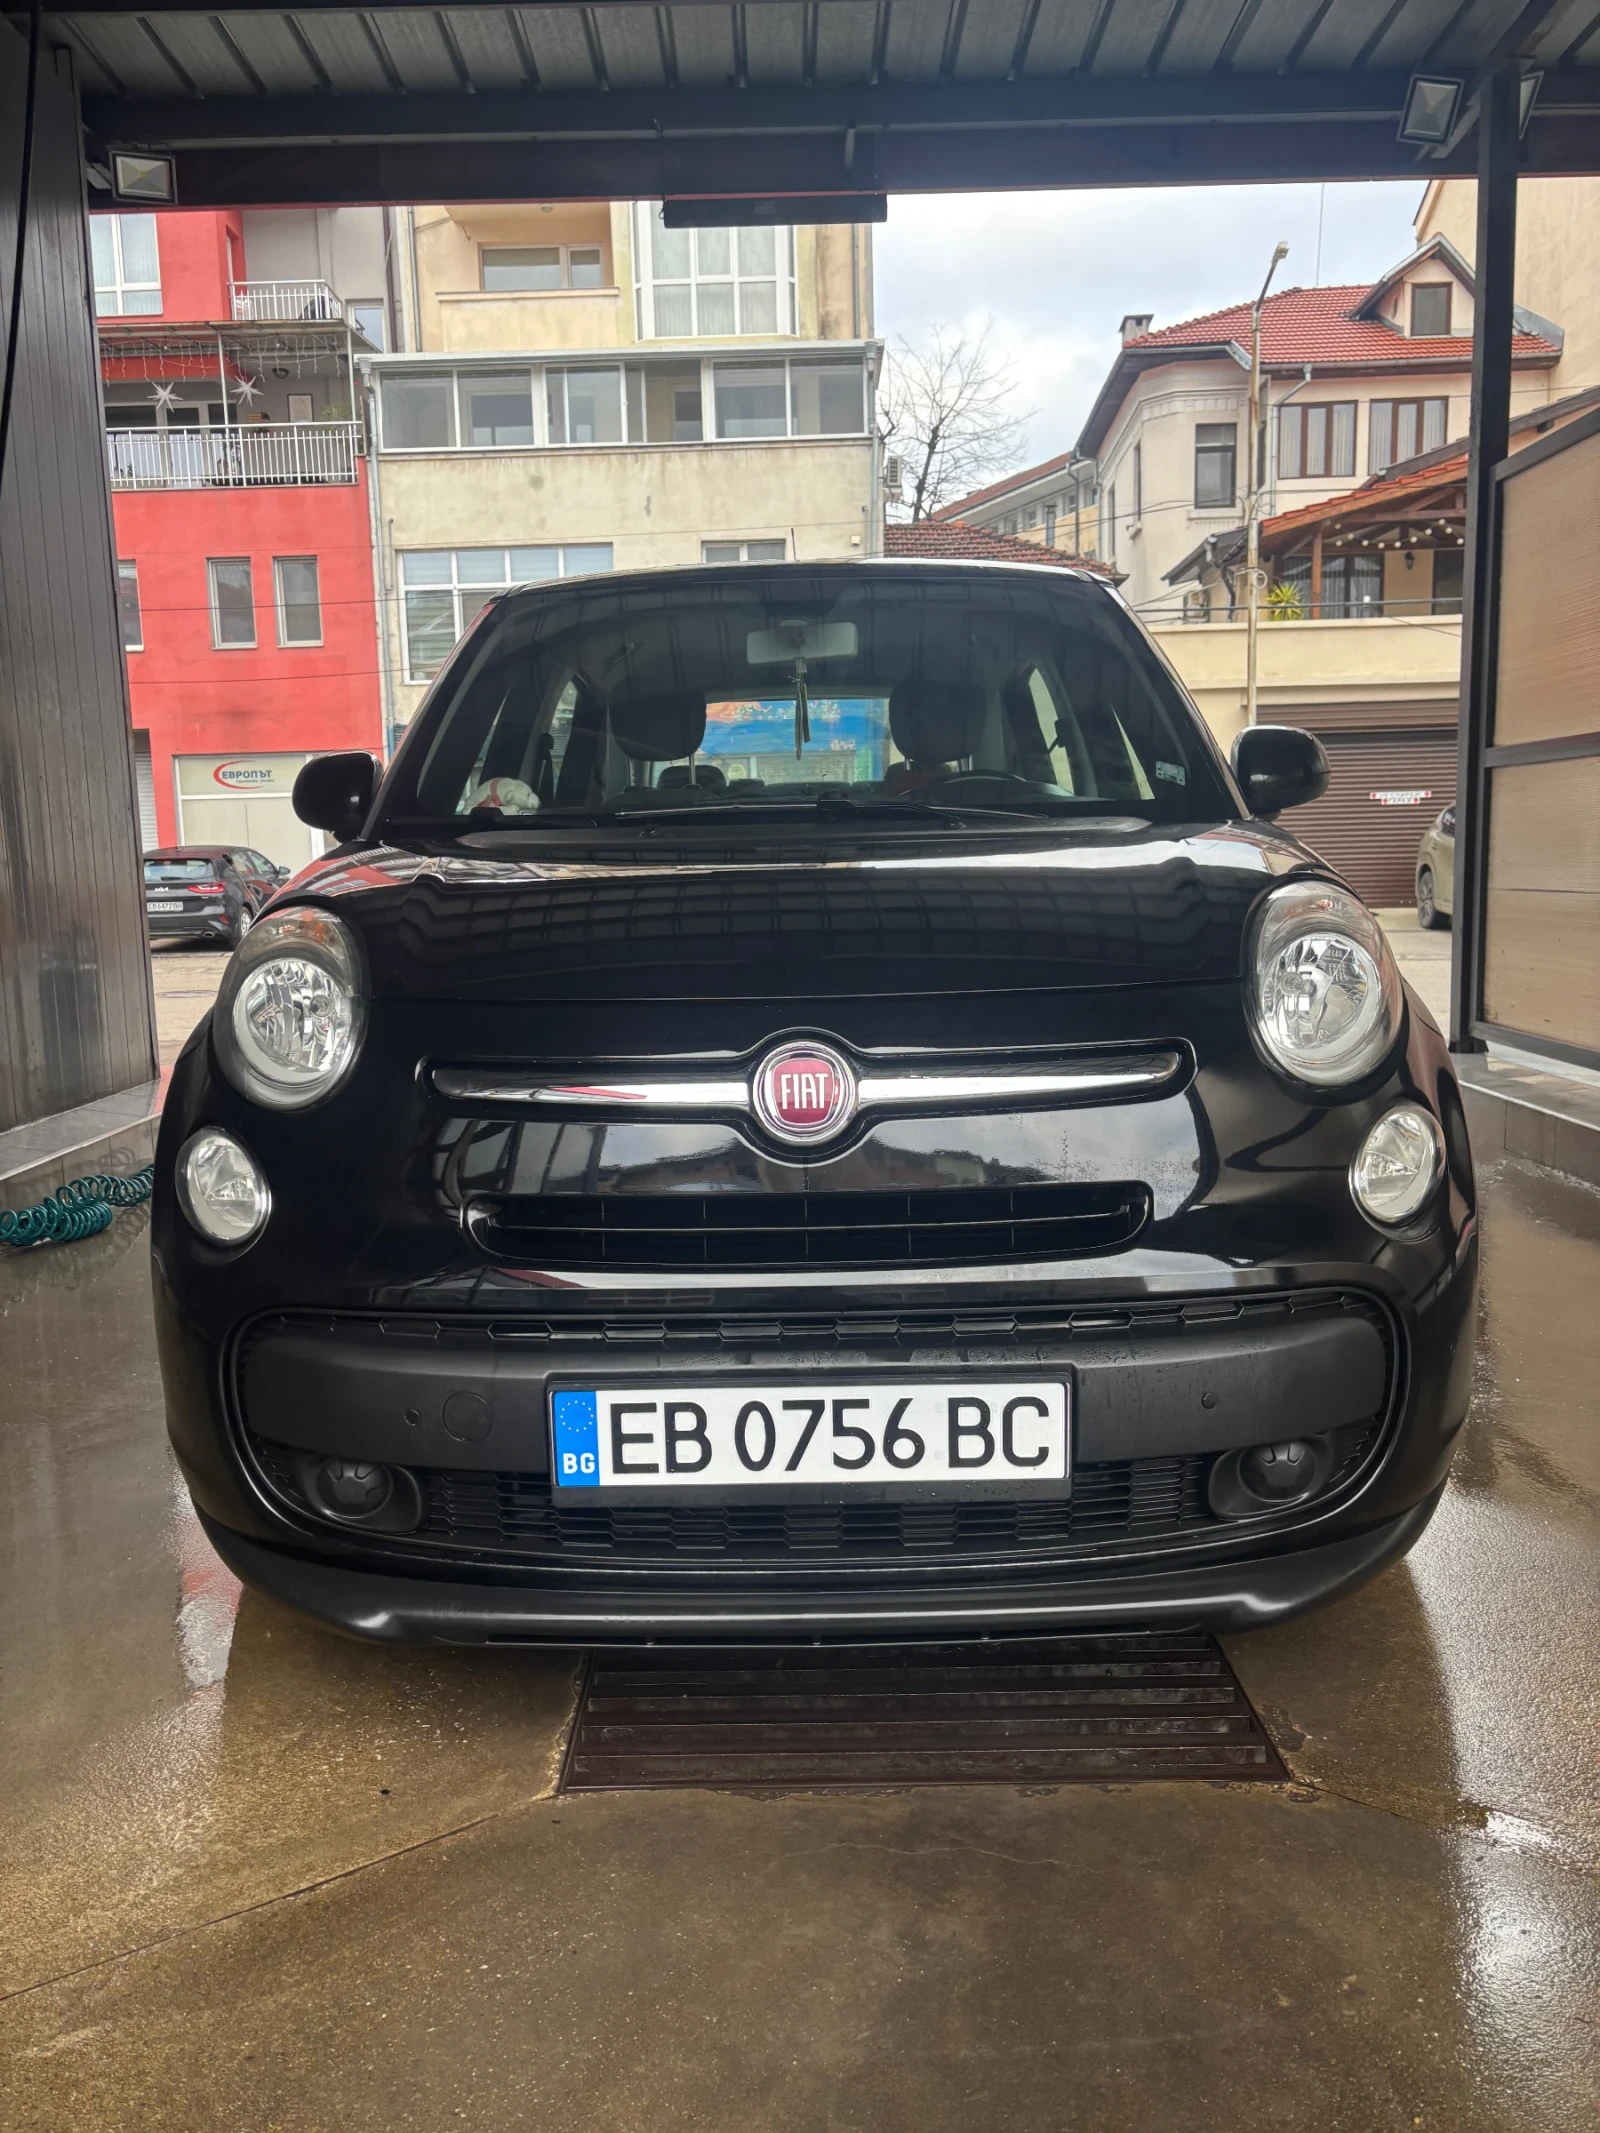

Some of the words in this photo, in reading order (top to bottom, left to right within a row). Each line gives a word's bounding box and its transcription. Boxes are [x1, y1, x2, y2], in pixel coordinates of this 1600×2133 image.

[221, 770, 272, 779] ЕВРОПЪТ
[780, 1073, 829, 1110] FIAT
[610, 1401, 712, 1474] EB
[734, 1397, 925, 1472] 0756
[948, 1396, 1049, 1468] BC
[563, 1452, 595, 1474] BG
